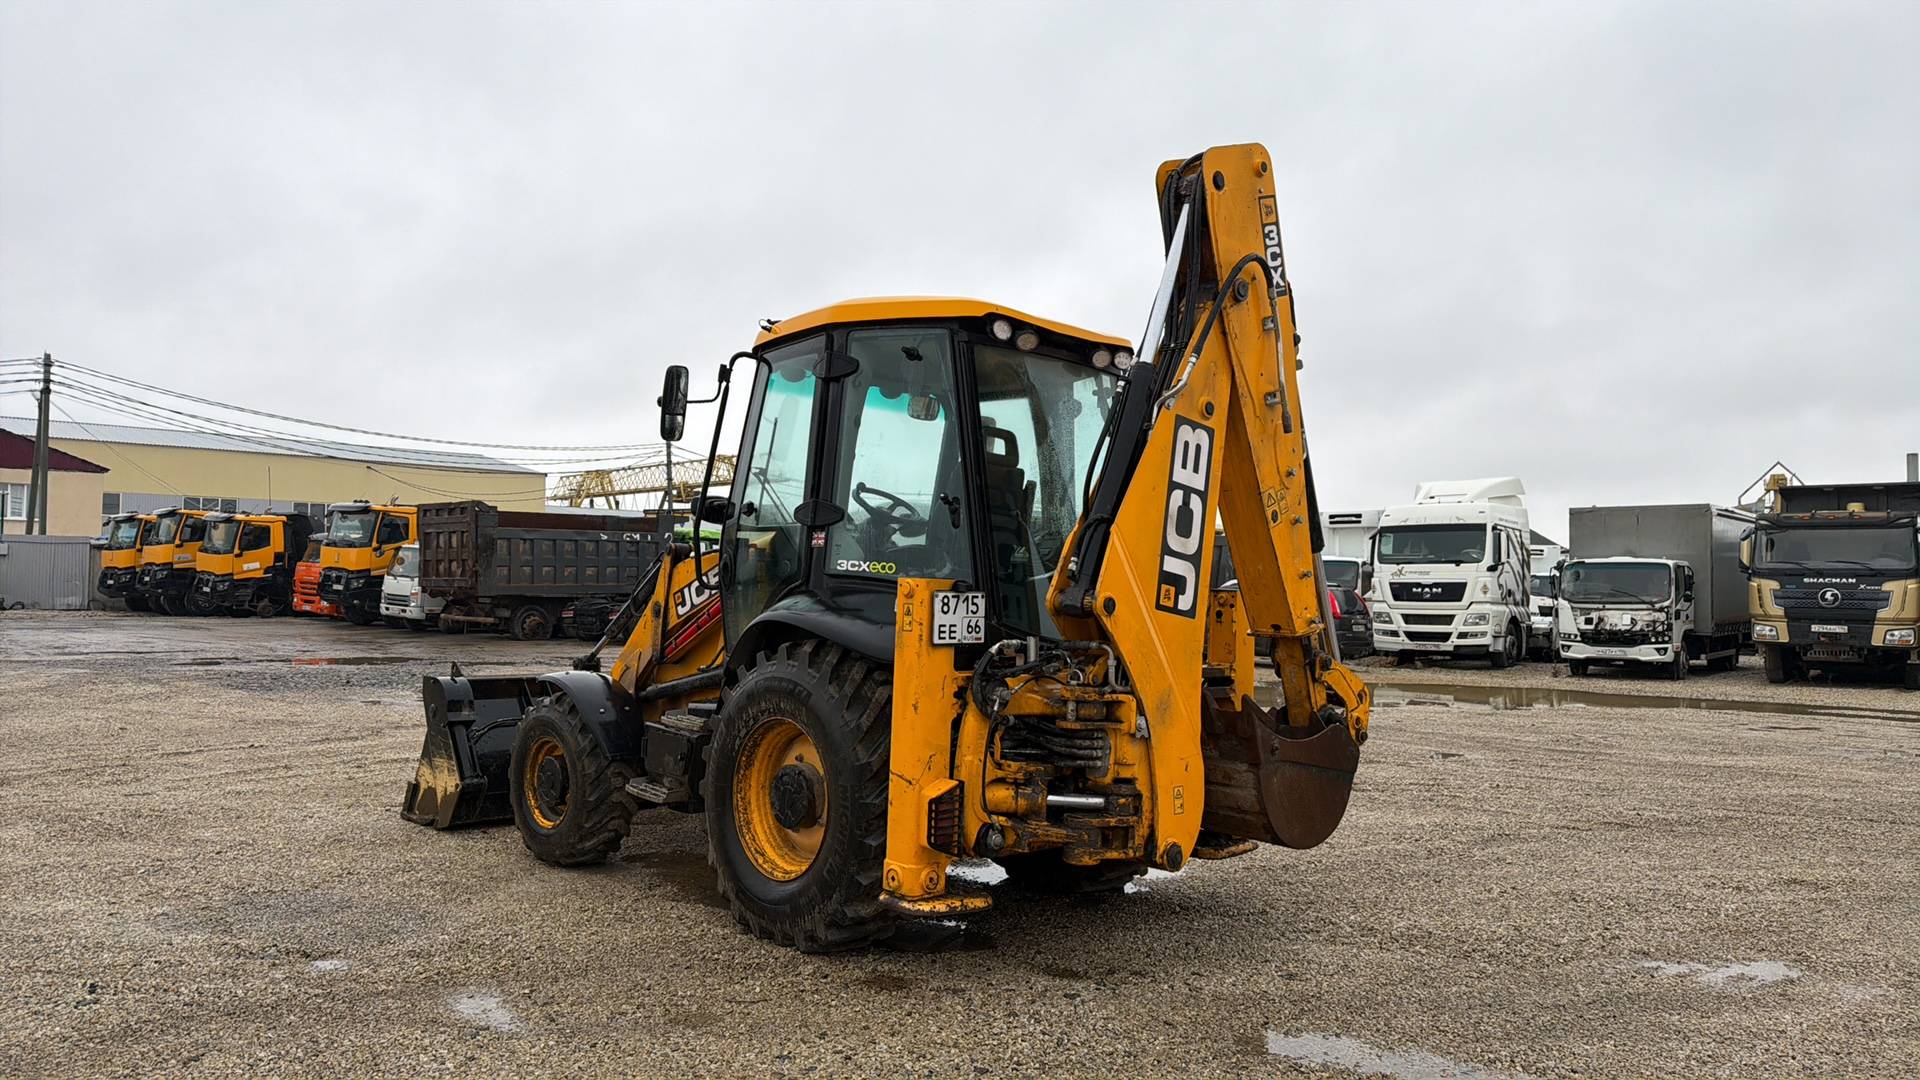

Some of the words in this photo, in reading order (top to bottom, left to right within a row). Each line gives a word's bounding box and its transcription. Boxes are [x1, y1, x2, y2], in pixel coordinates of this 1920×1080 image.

[1264, 224, 1285, 287] 3CX
[1163, 424, 1210, 611] JCB
[836, 559, 896, 574] 3CXeco
[940, 594, 980, 616] 8715
[966, 619, 982, 635] 66
